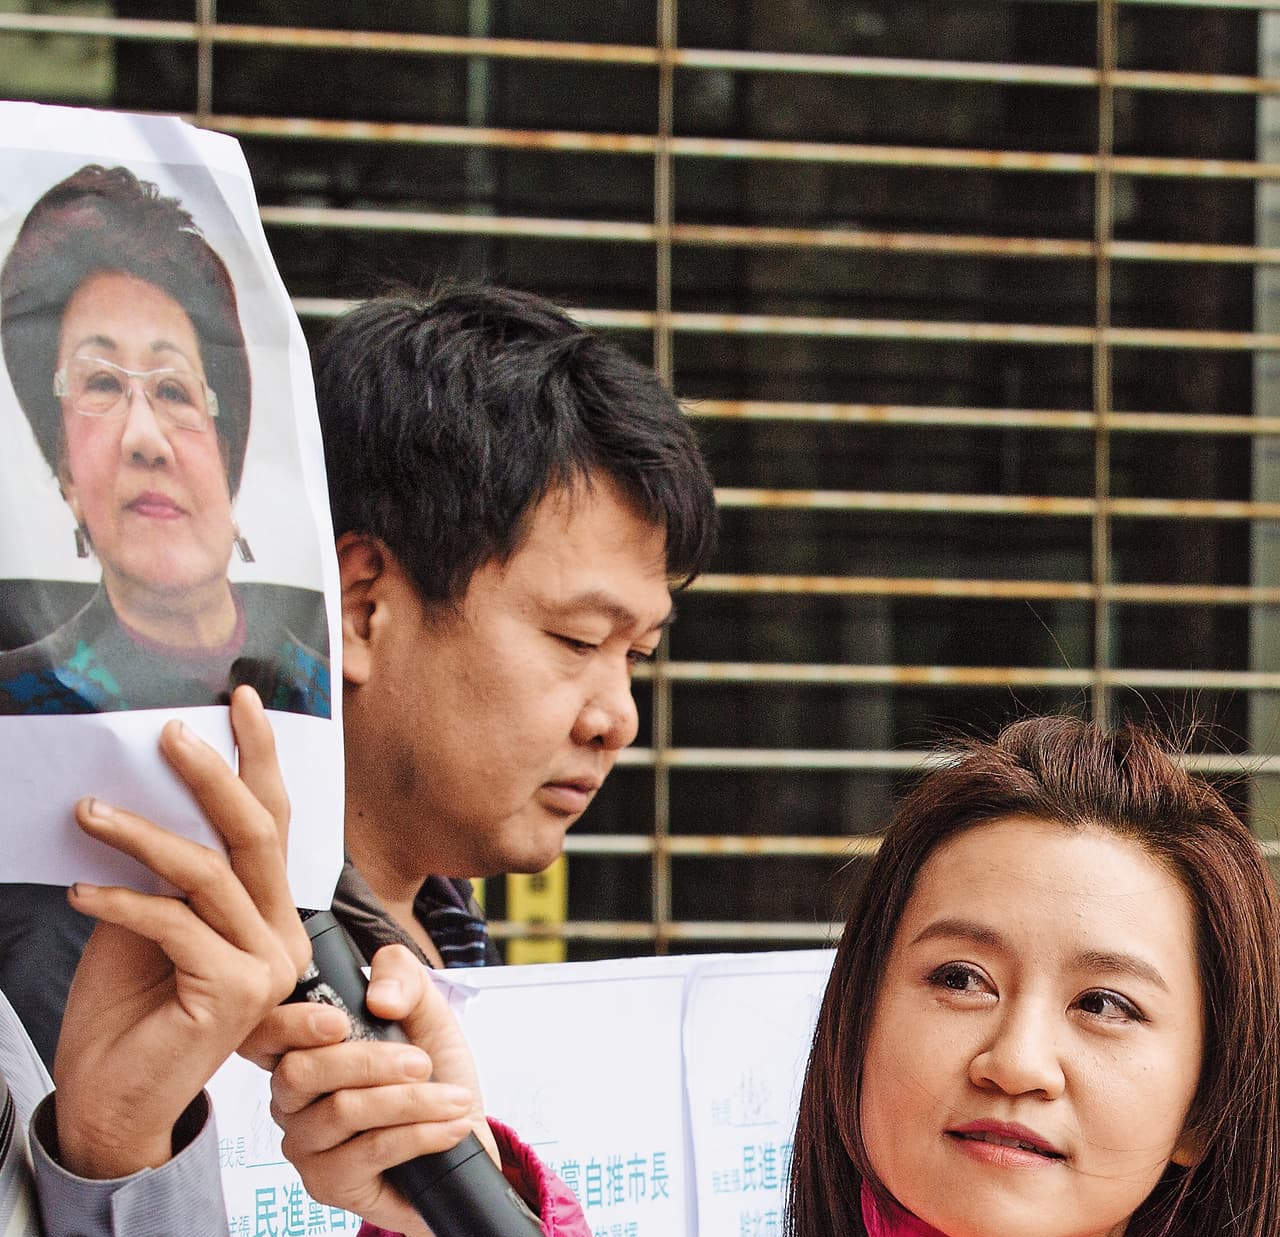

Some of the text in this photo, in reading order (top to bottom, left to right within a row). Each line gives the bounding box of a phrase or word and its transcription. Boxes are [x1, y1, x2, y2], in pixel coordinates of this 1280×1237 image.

[546, 1151, 670, 1209] 黨自推市長
